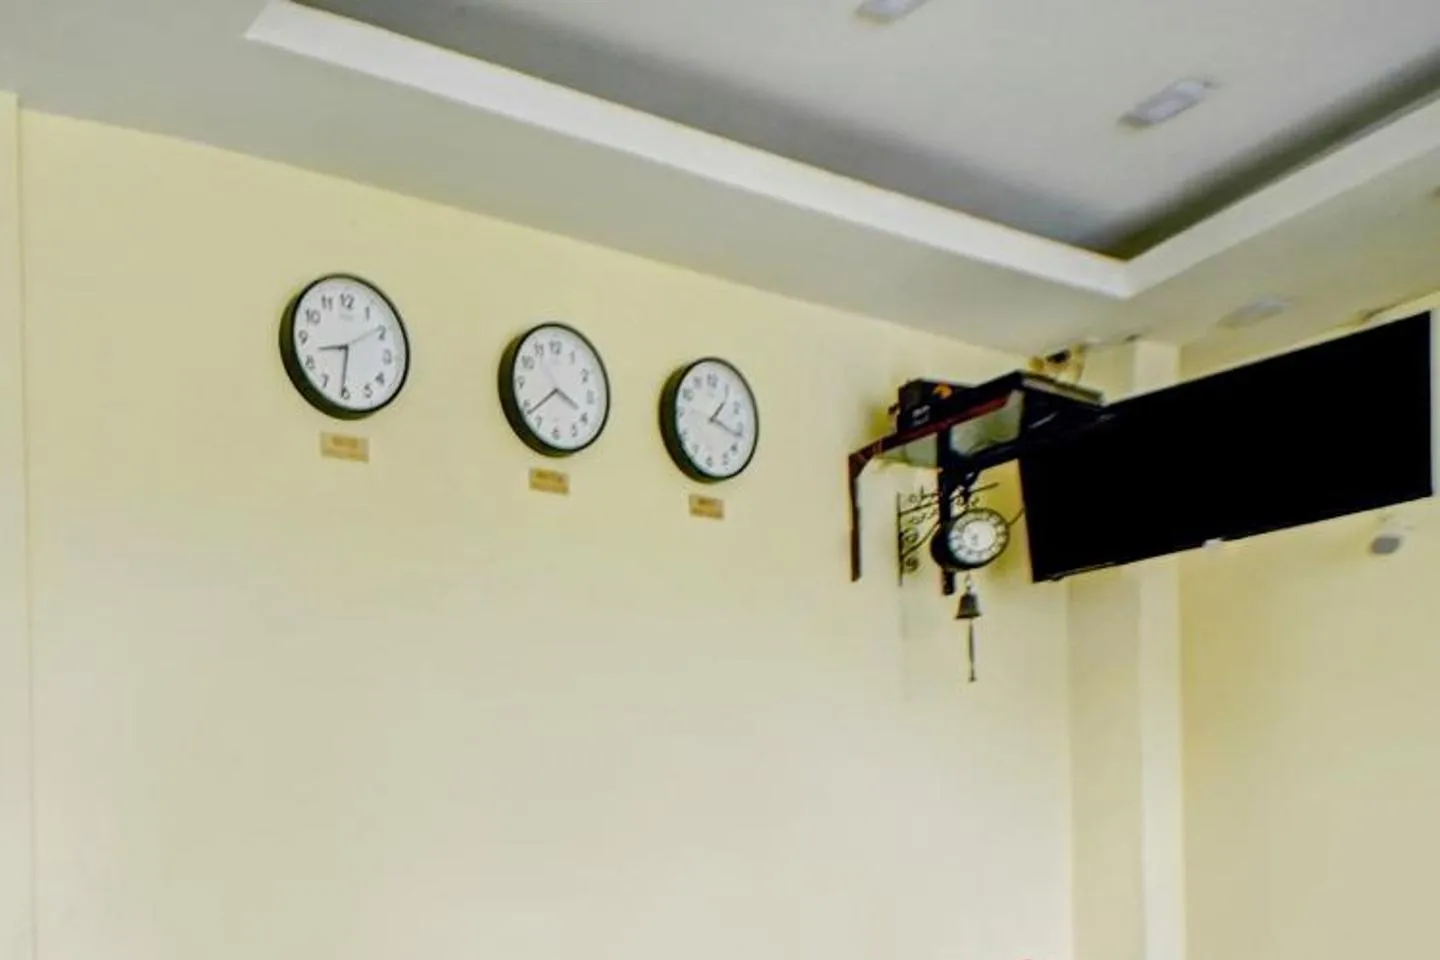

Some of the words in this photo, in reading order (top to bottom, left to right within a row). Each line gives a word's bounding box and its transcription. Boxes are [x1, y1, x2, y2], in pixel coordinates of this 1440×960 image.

[321, 294, 333, 311] 11
[340, 294, 354, 309] 12
[305, 308, 320, 324] 10
[365, 305, 370, 320] 1
[299, 329, 308, 344] 9
[376, 324, 386, 341] 2
[549, 340, 562, 355] 12
[321, 373, 329, 389] 7
